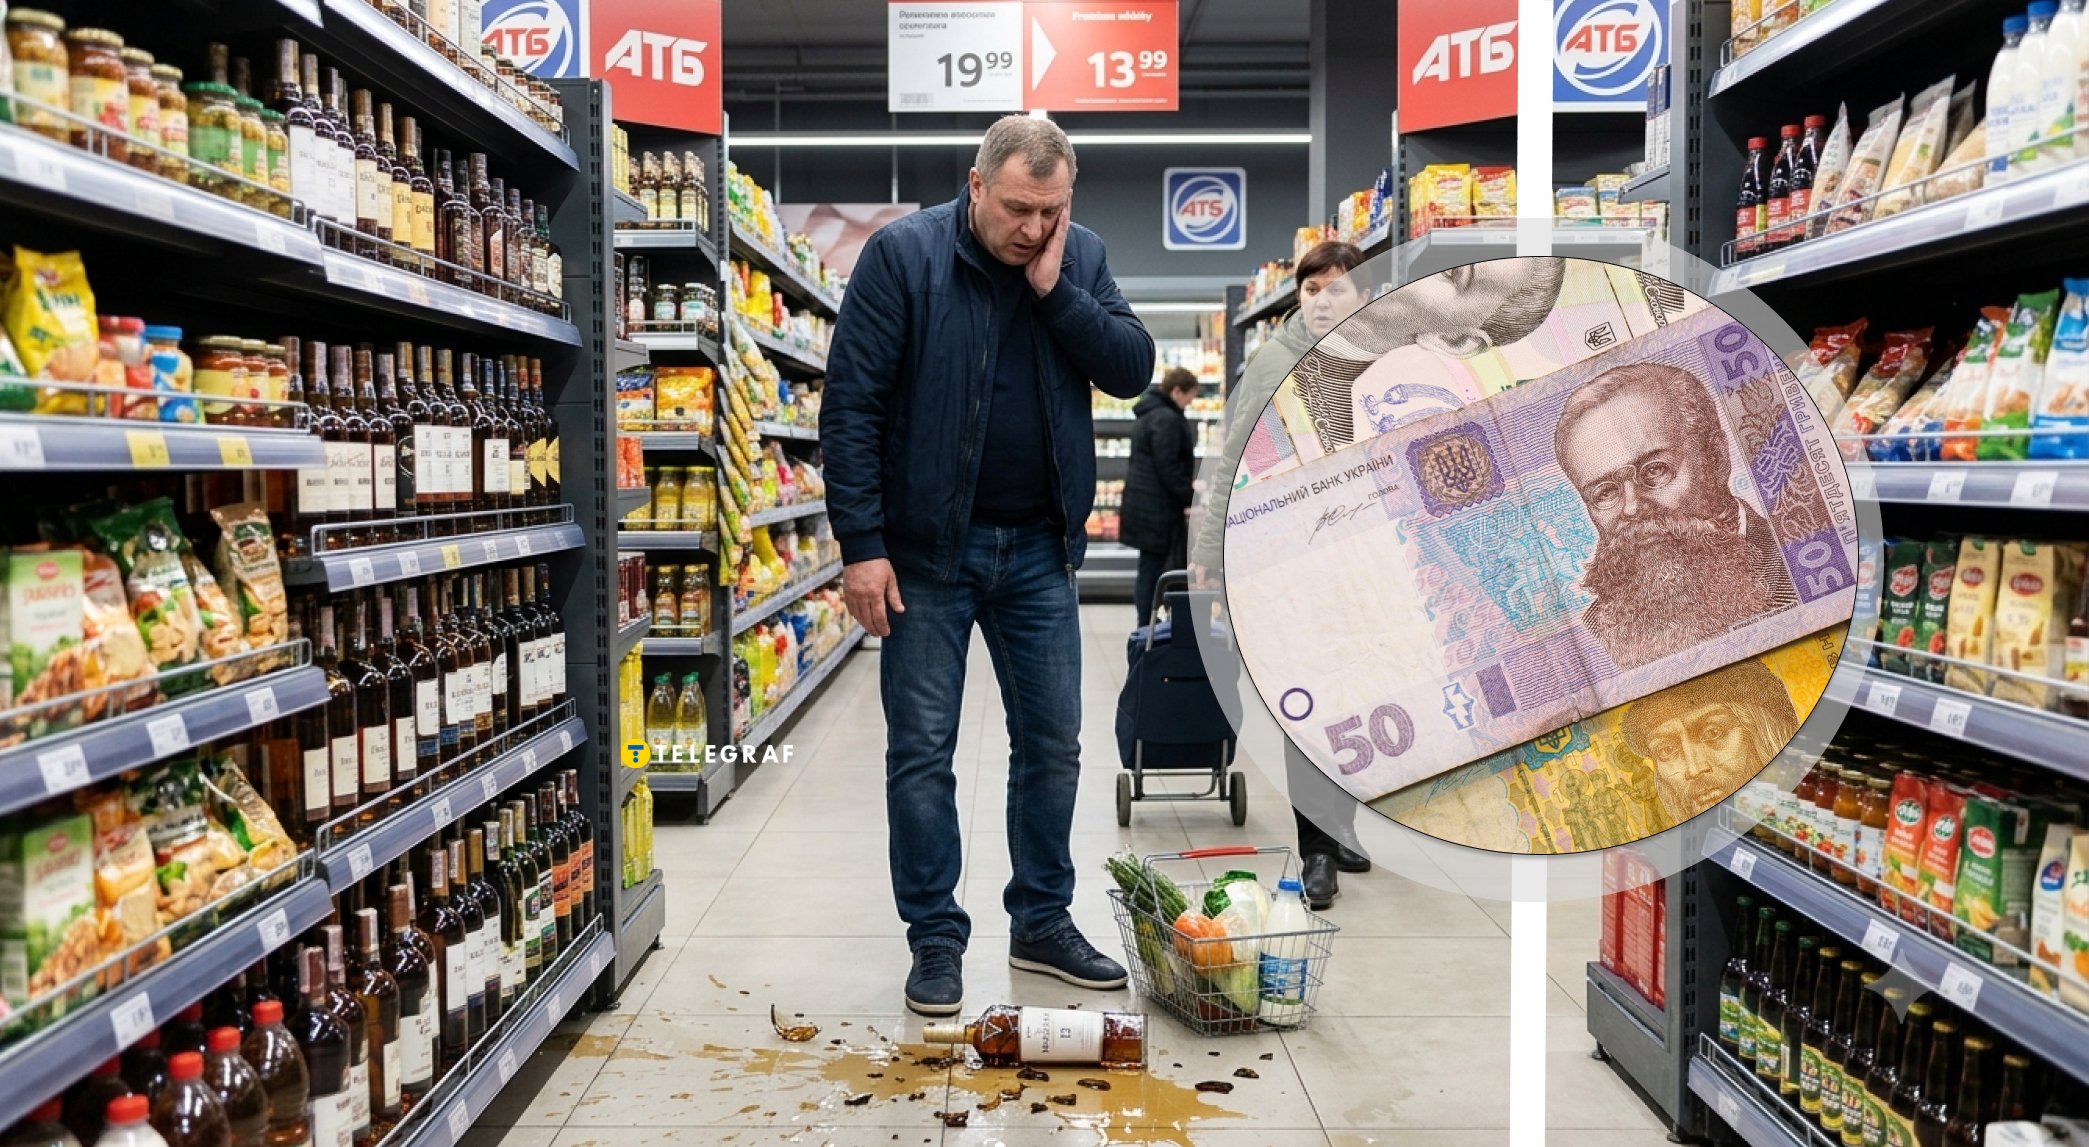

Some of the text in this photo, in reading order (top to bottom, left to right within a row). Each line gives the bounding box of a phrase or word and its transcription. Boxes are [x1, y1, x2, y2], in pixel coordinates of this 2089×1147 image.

[605, 29, 708, 87] АТБ
[1412, 20, 1519, 86] АТБ
[1565, 24, 1640, 53] АТБ
[1715, 325, 1759, 380] 50
[1226, 454, 1394, 529] АЦІОНАЛЬНИЙ БАНК УКРАЇНИ
[1367, 484, 1400, 501] ГОЛОВА
[1798, 541, 1844, 597] 50
[1324, 702, 1415, 776] 50
